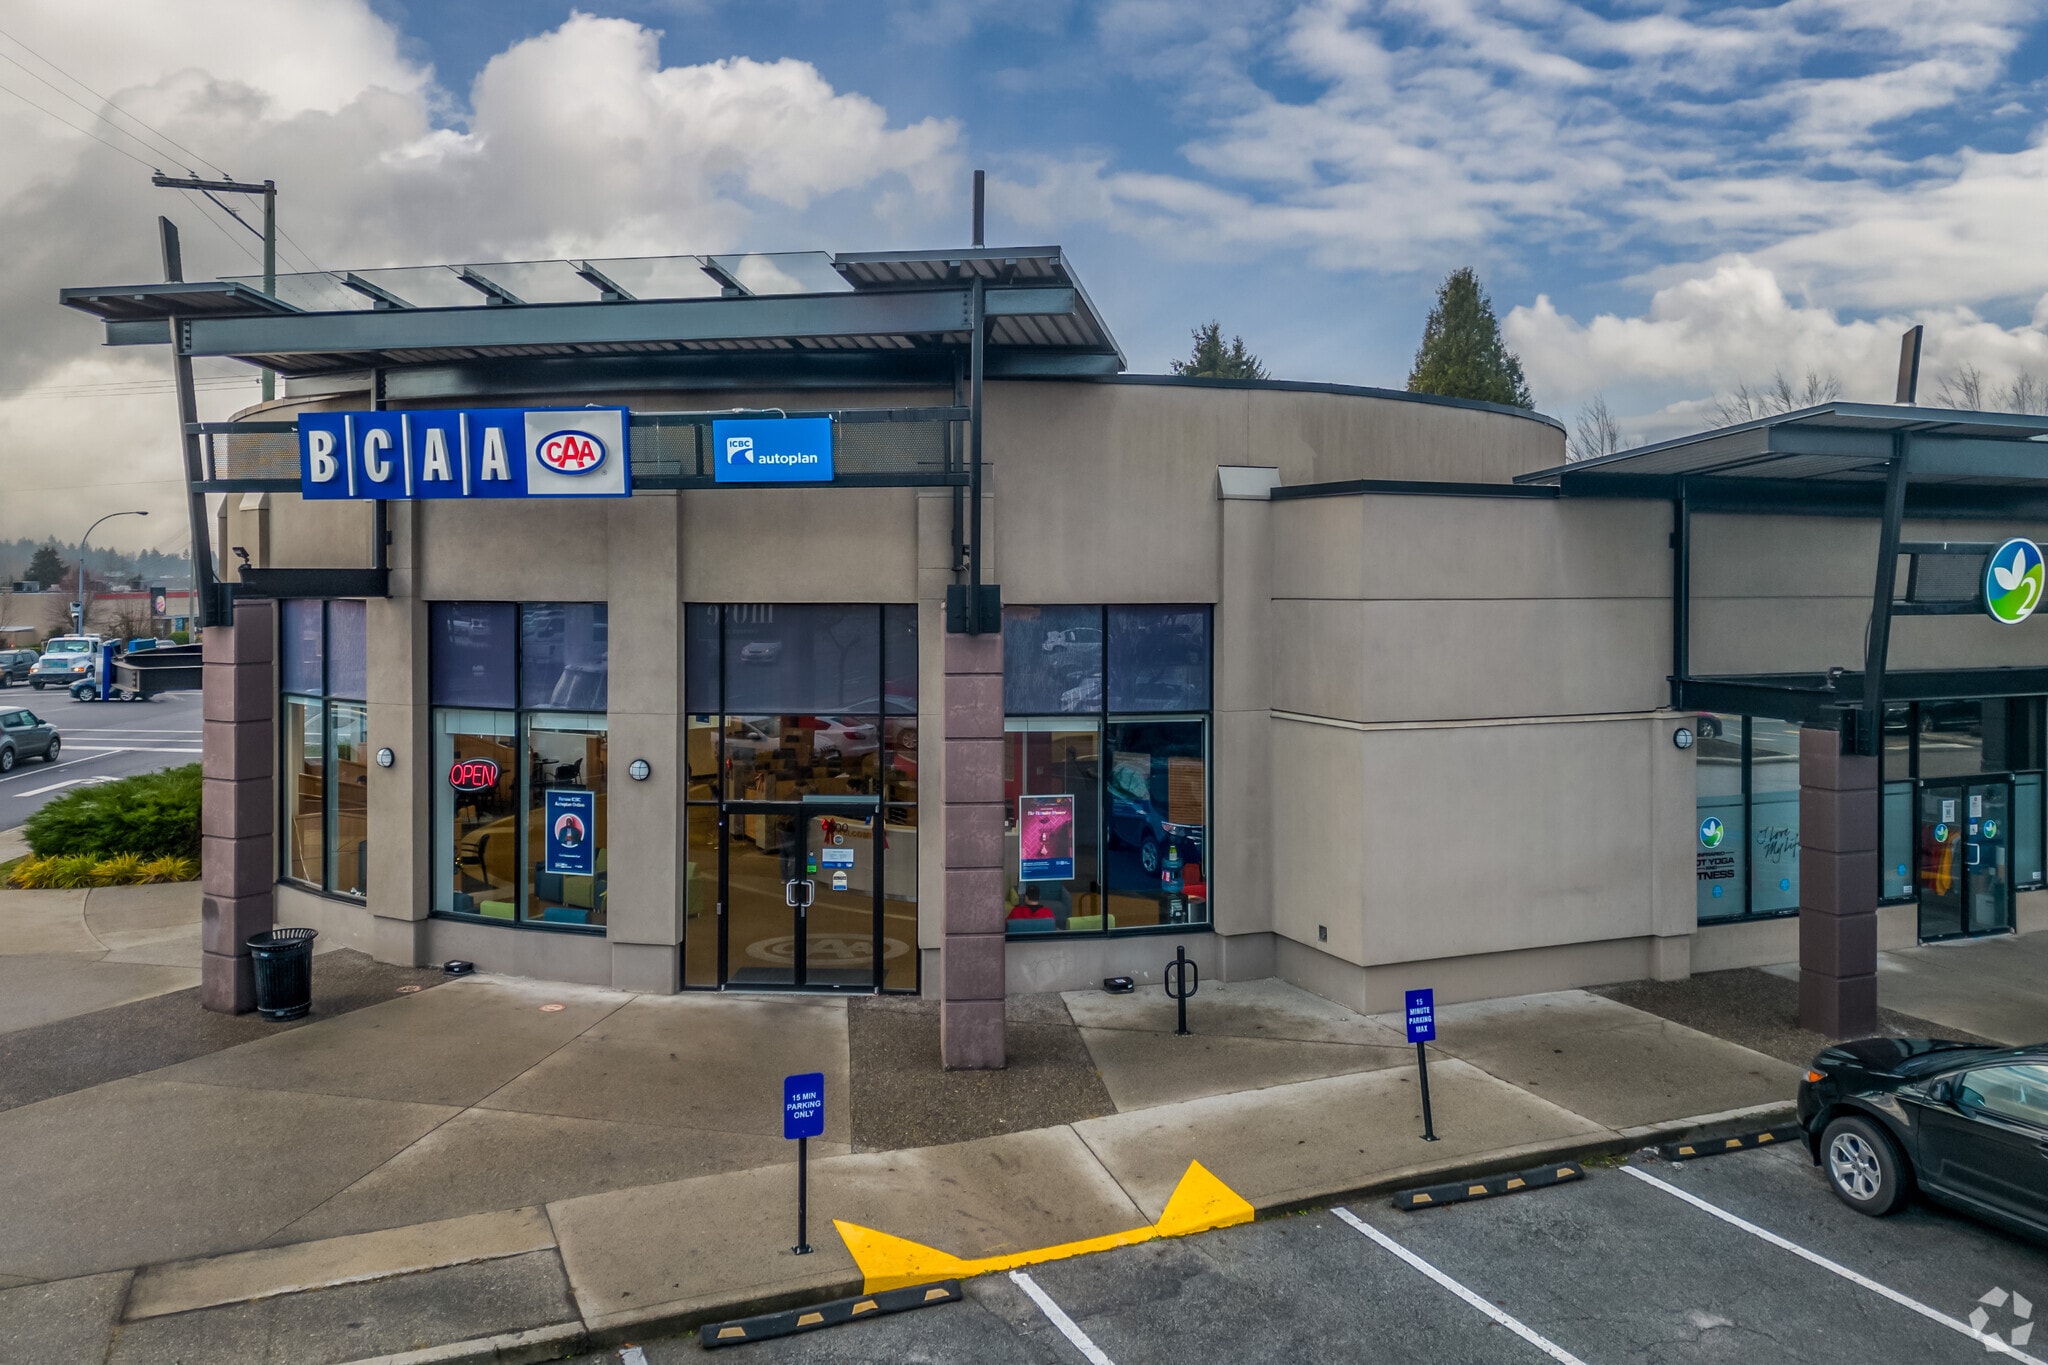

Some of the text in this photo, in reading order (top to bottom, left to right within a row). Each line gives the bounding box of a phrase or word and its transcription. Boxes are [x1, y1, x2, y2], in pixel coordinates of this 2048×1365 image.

[729, 440, 750, 448] ICBC
[546, 436, 596, 469] CAA
[758, 452, 818, 466] autoplan
[451, 764, 495, 786] OPEN
[1764, 833, 1800, 864] My Lif
[1708, 857, 1734, 865] YOGA
[1697, 870, 1734, 880] TNESS
[1410, 1007, 1430, 1015] MINUTE
[1409, 1016, 1432, 1025] PARKING
[1416, 1025, 1428, 1033] MAX
[792, 1092, 817, 1102] 15 MIN
[786, 1100, 821, 1111] PARKING
[794, 1110, 814, 1119] ONLY
